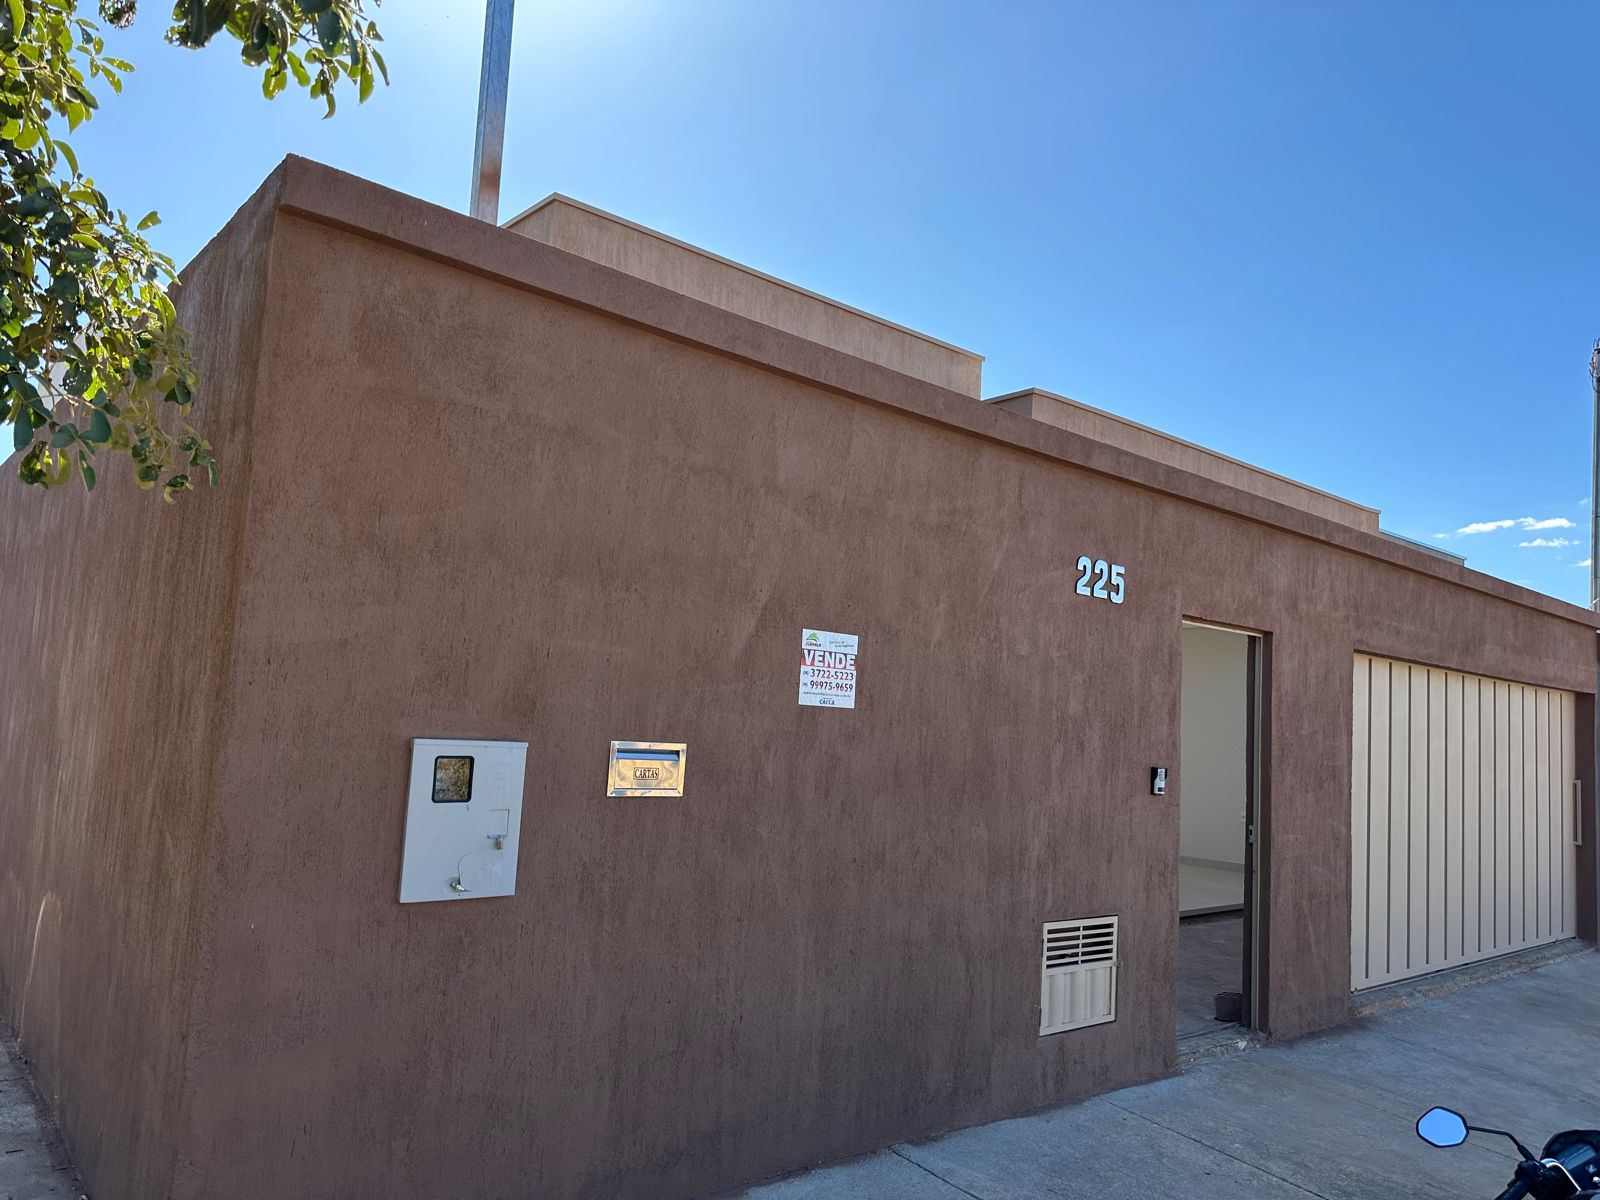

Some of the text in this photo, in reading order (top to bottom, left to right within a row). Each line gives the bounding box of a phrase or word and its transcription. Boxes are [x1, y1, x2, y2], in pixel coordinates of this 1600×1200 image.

[1075, 555, 1126, 604] 225
[803, 650, 856, 670] VENDE
[810, 668, 854, 681] 3722-5223
[809, 680, 854, 692] 99975-9659
[635, 769, 658, 778] CARTAS
